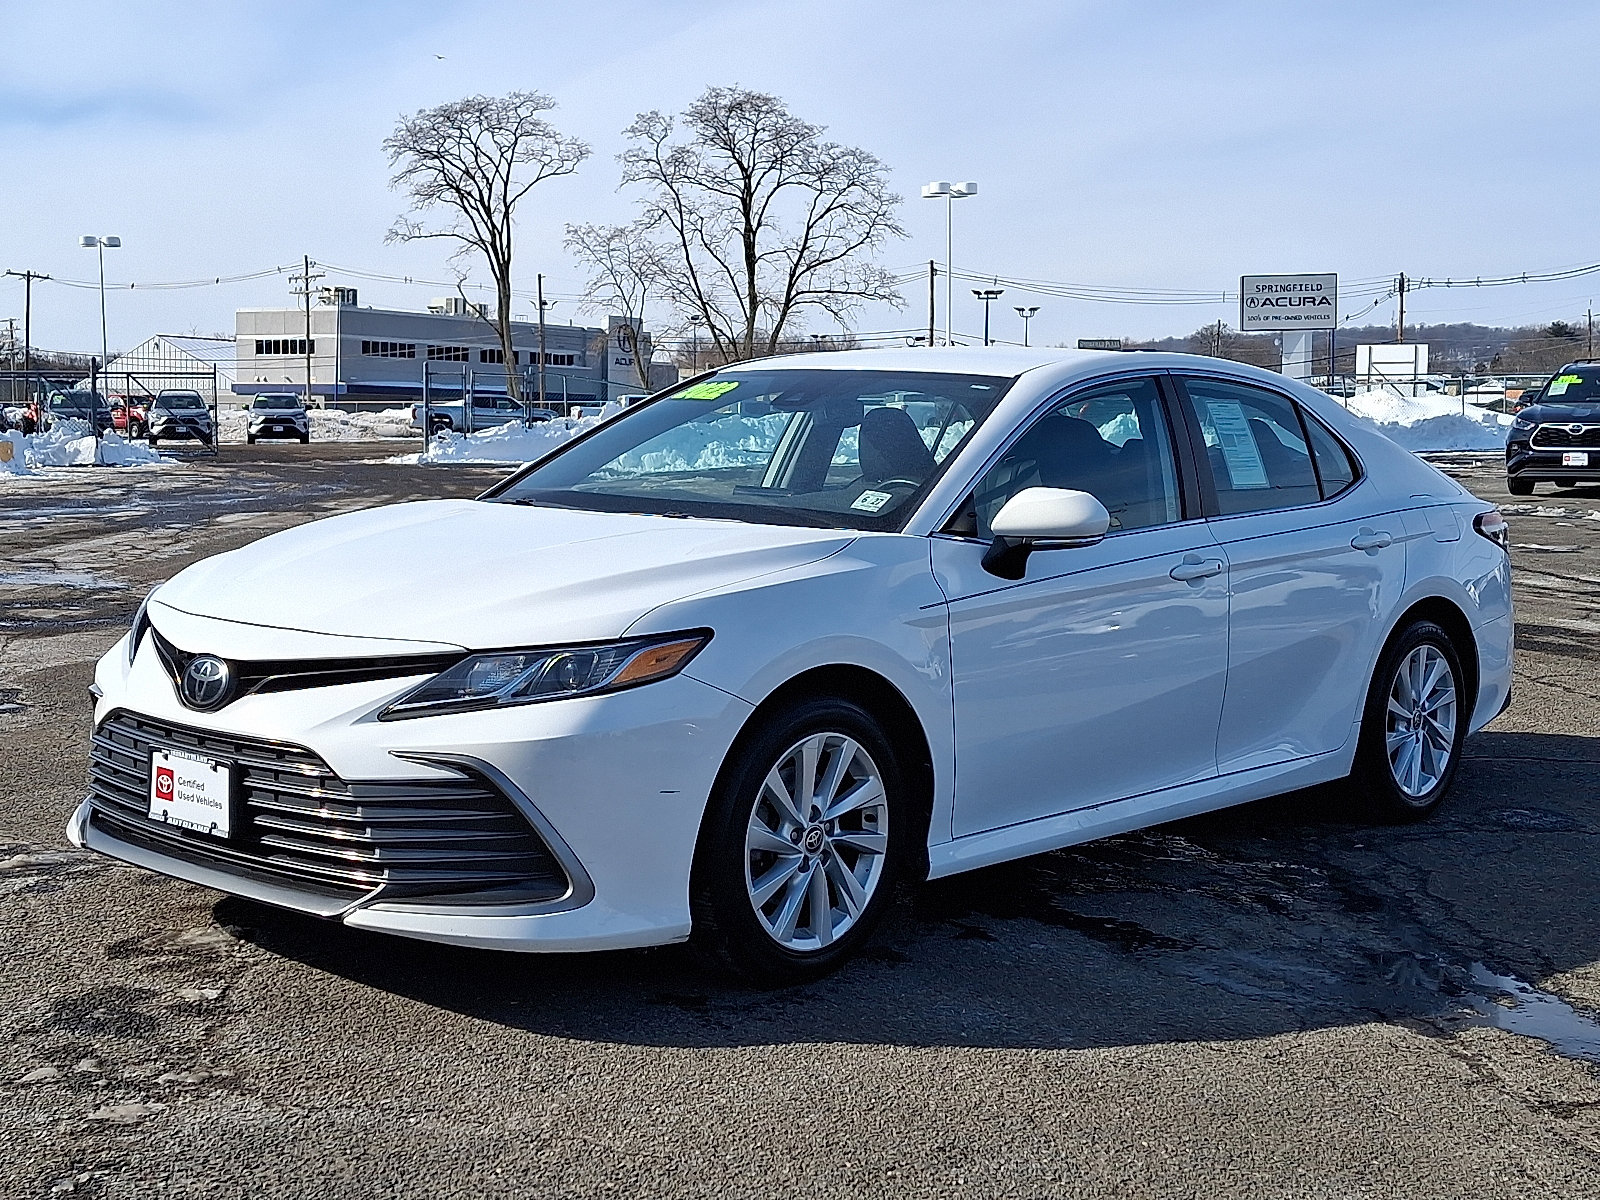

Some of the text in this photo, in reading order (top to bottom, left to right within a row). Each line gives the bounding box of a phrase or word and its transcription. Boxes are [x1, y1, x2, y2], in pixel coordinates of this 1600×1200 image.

[1255, 283, 1323, 293] SPRINGFIELD
[1260, 295, 1332, 308] ACURA
[177, 776, 205, 792] Certified
[177, 790, 223, 810] Used Vehicles
